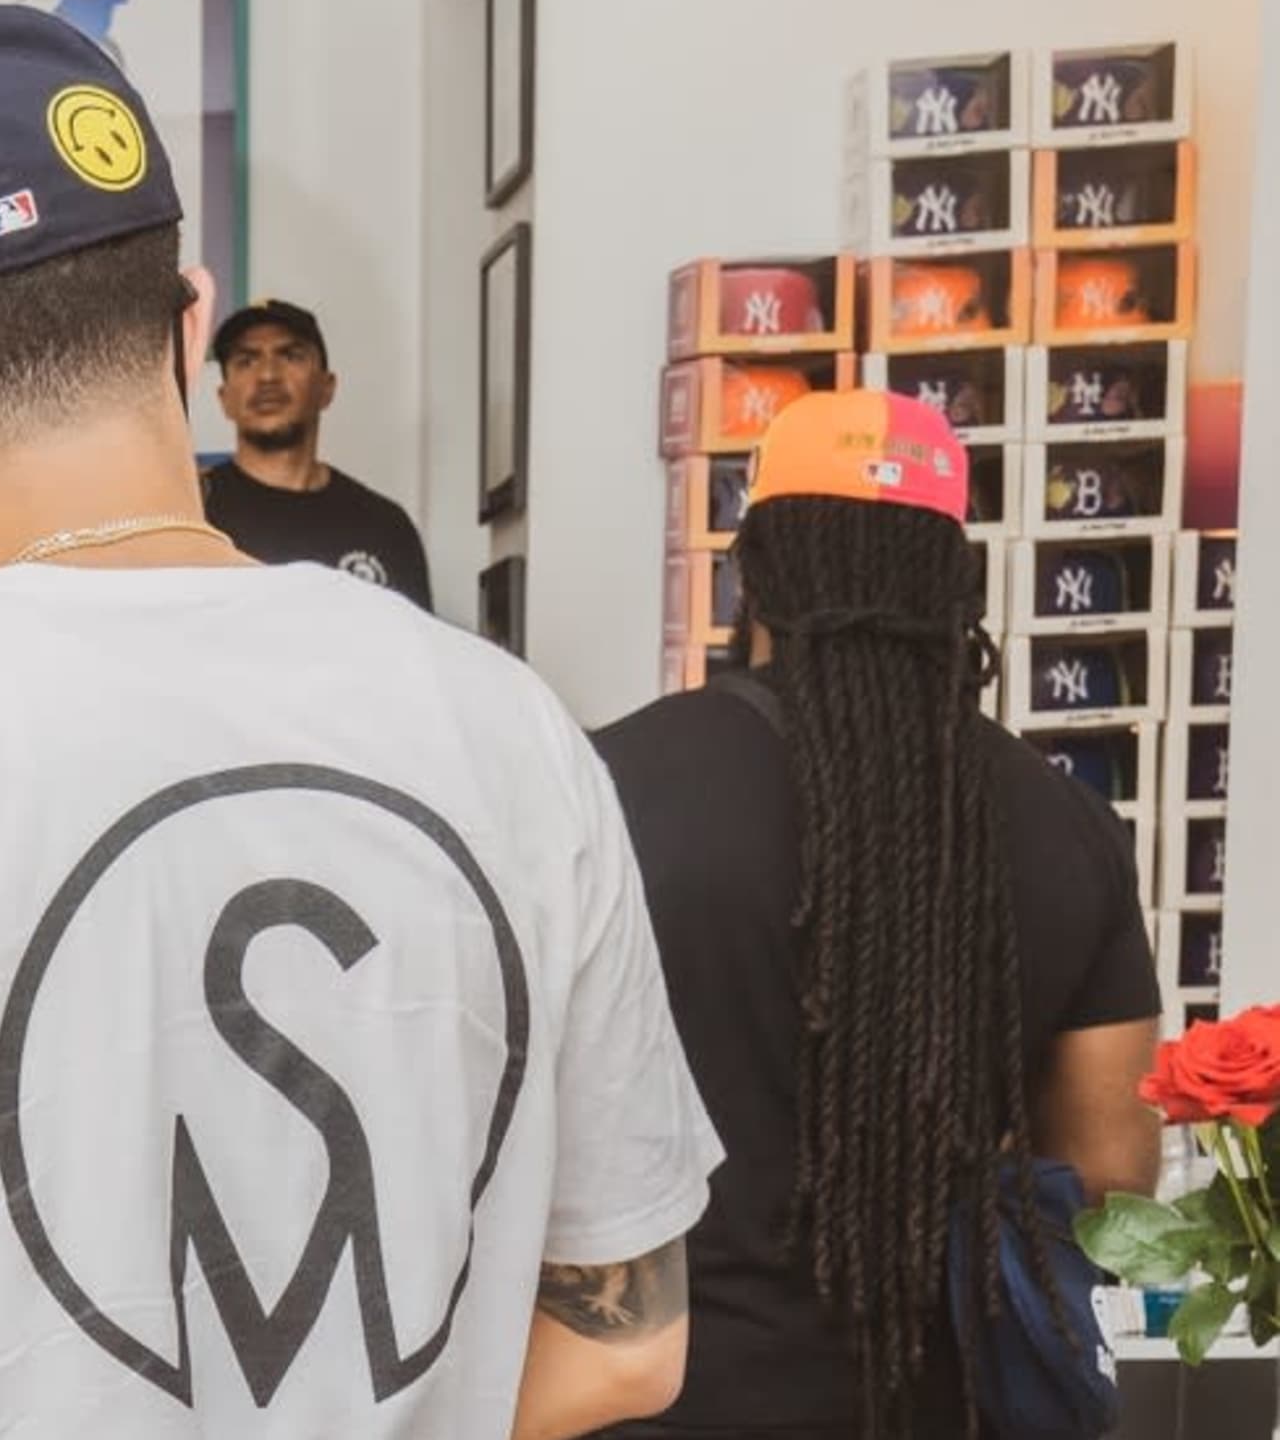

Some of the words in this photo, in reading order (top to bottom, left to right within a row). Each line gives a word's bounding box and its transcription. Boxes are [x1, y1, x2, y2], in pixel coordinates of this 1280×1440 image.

[916, 87, 958, 135] NY
[1078, 74, 1120, 123] NY
[916, 185, 957, 232] NY
[1076, 184, 1114, 227] NY
[745, 290, 781, 334] NY
[1072, 469, 1102, 515] B
[1056, 567, 1093, 612] NY
[1050, 660, 1089, 702] NY
